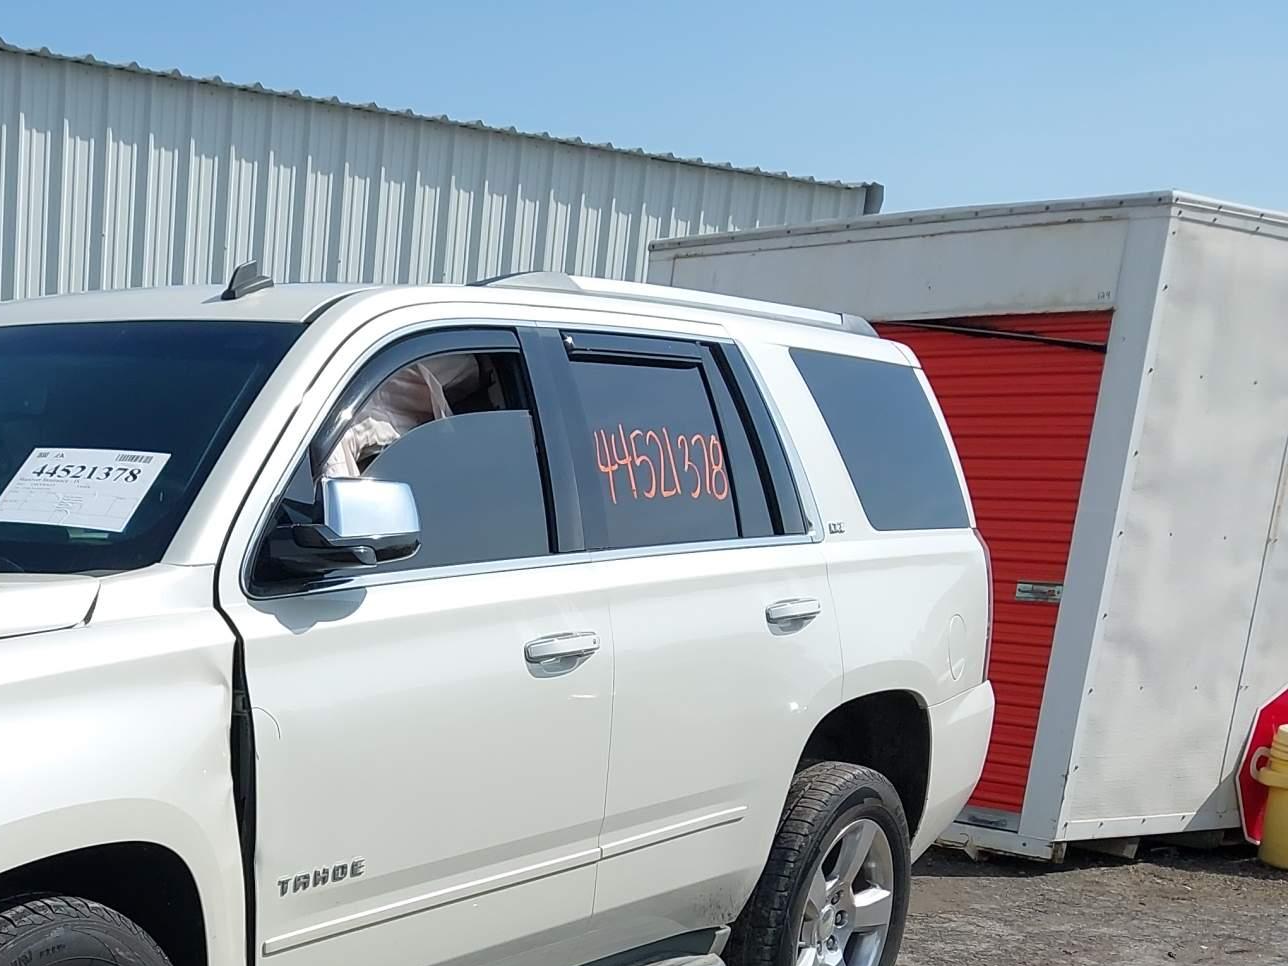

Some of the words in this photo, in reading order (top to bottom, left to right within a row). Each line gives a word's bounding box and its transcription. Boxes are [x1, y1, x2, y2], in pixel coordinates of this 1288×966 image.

[32, 463, 142, 483] 44521378
[593, 424, 730, 504] 44521378
[277, 858, 366, 897] TAHOE
